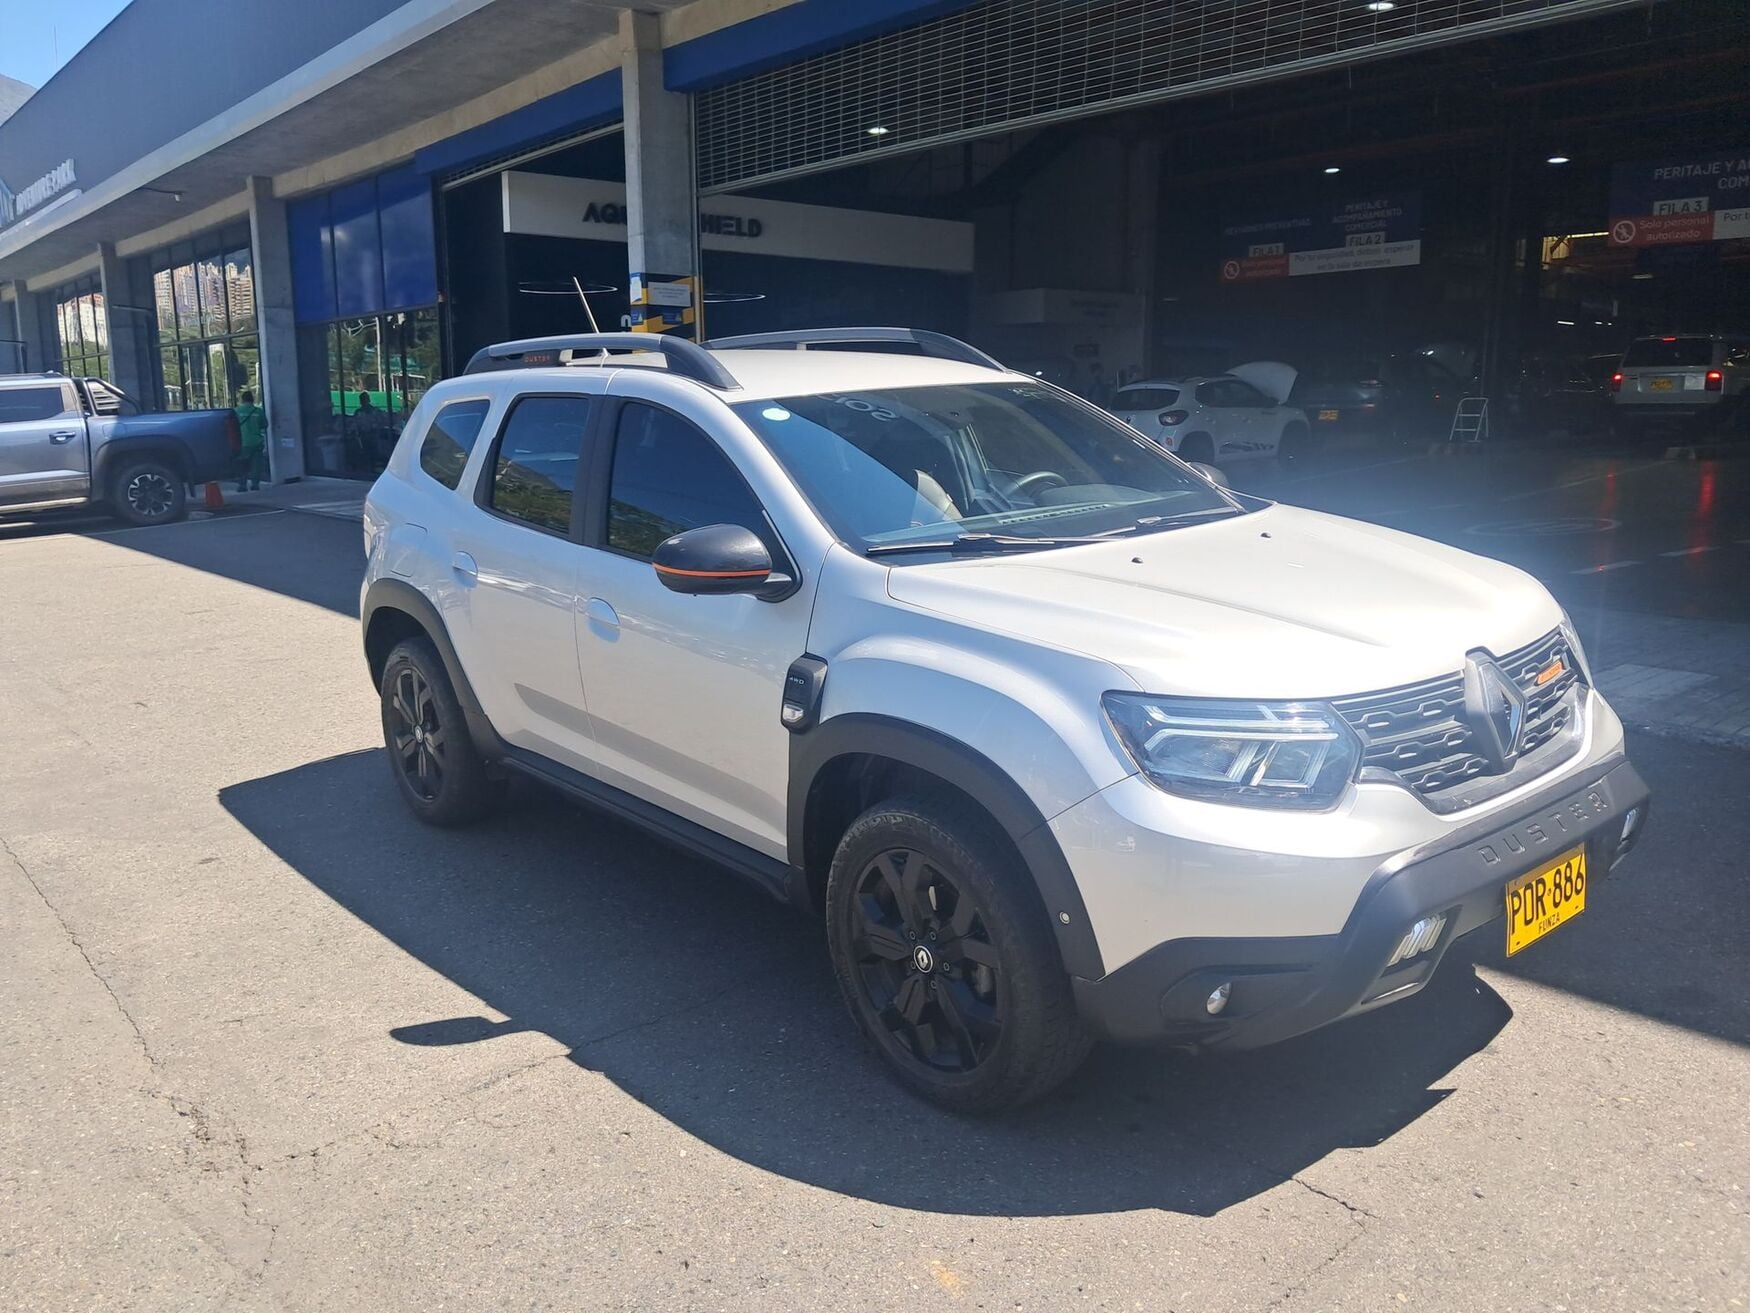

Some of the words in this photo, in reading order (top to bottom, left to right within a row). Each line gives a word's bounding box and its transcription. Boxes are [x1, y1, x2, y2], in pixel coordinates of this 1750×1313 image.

[1654, 163, 1720, 179] PERITAJE
[1724, 161, 1735, 172] Y
[1737, 159, 1750, 171] A
[1659, 202, 1691, 214] FILA
[1694, 200, 1703, 211] 3
[1723, 212, 1743, 222] Por
[701, 213, 762, 238] HIELD
[1349, 235, 1374, 247] FILA
[1375, 234, 1382, 244] 2
[1478, 791, 1608, 866] DUSTER
[1539, 912, 1560, 934] FUNZA
